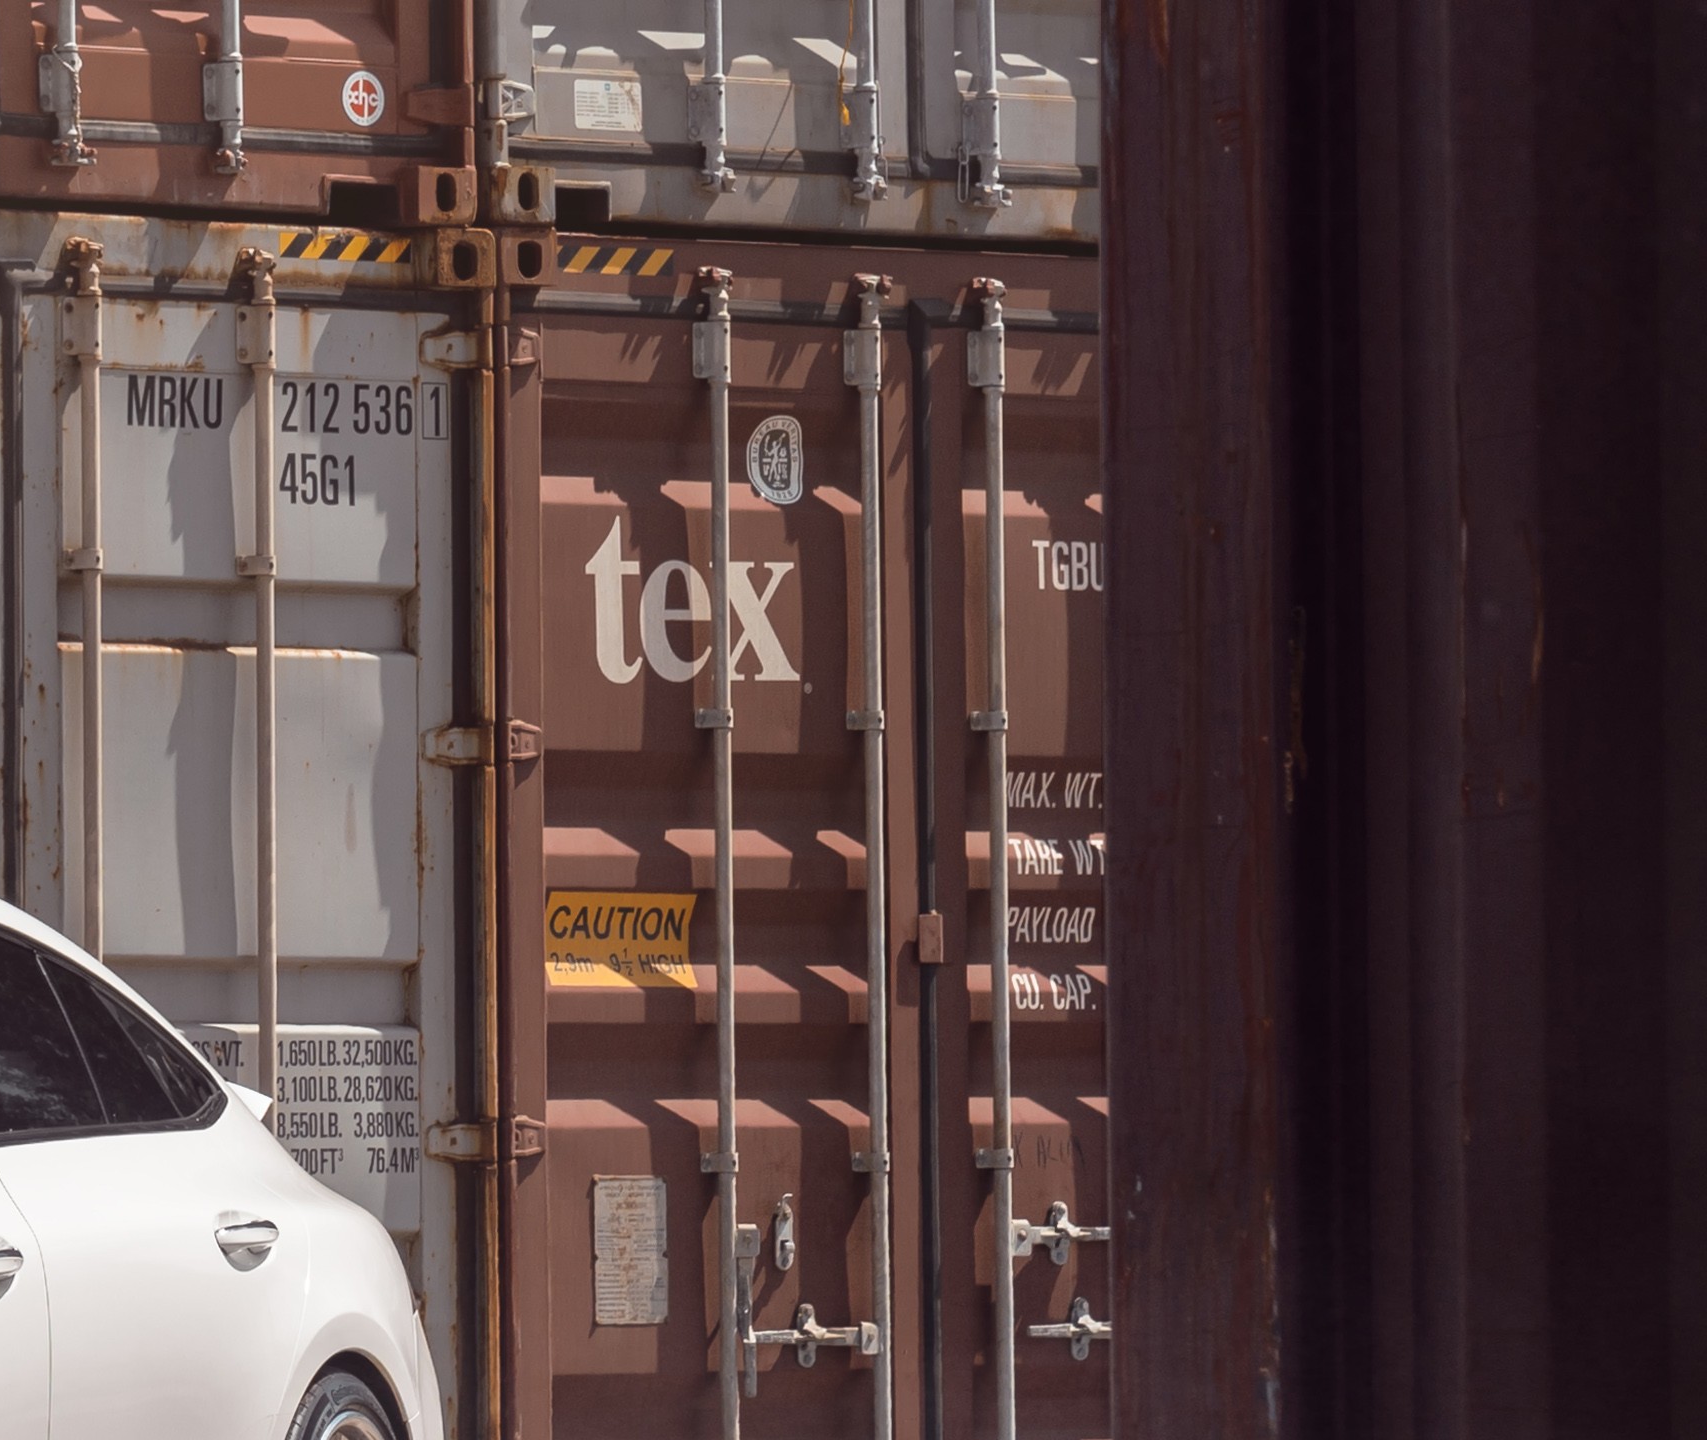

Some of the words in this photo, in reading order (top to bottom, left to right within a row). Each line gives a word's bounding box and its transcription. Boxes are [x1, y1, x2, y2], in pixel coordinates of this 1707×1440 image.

[127, 374, 223, 429] MRKU
[281, 381, 339, 433] 212
[353, 384, 413, 436] 536
[752, 421, 778, 463] BUREAU
[279, 453, 357, 507] 45G1
[585, 514, 801, 684] tex
[1008, 839, 1063, 875] TARE
[549, 905, 686, 941] CAUTION
[1008, 907, 1096, 943] PAYLOAD
[638, 953, 686, 975] HIGH
[1011, 973, 1045, 1010] CU.
[1050, 973, 1097, 1010] CAP.
